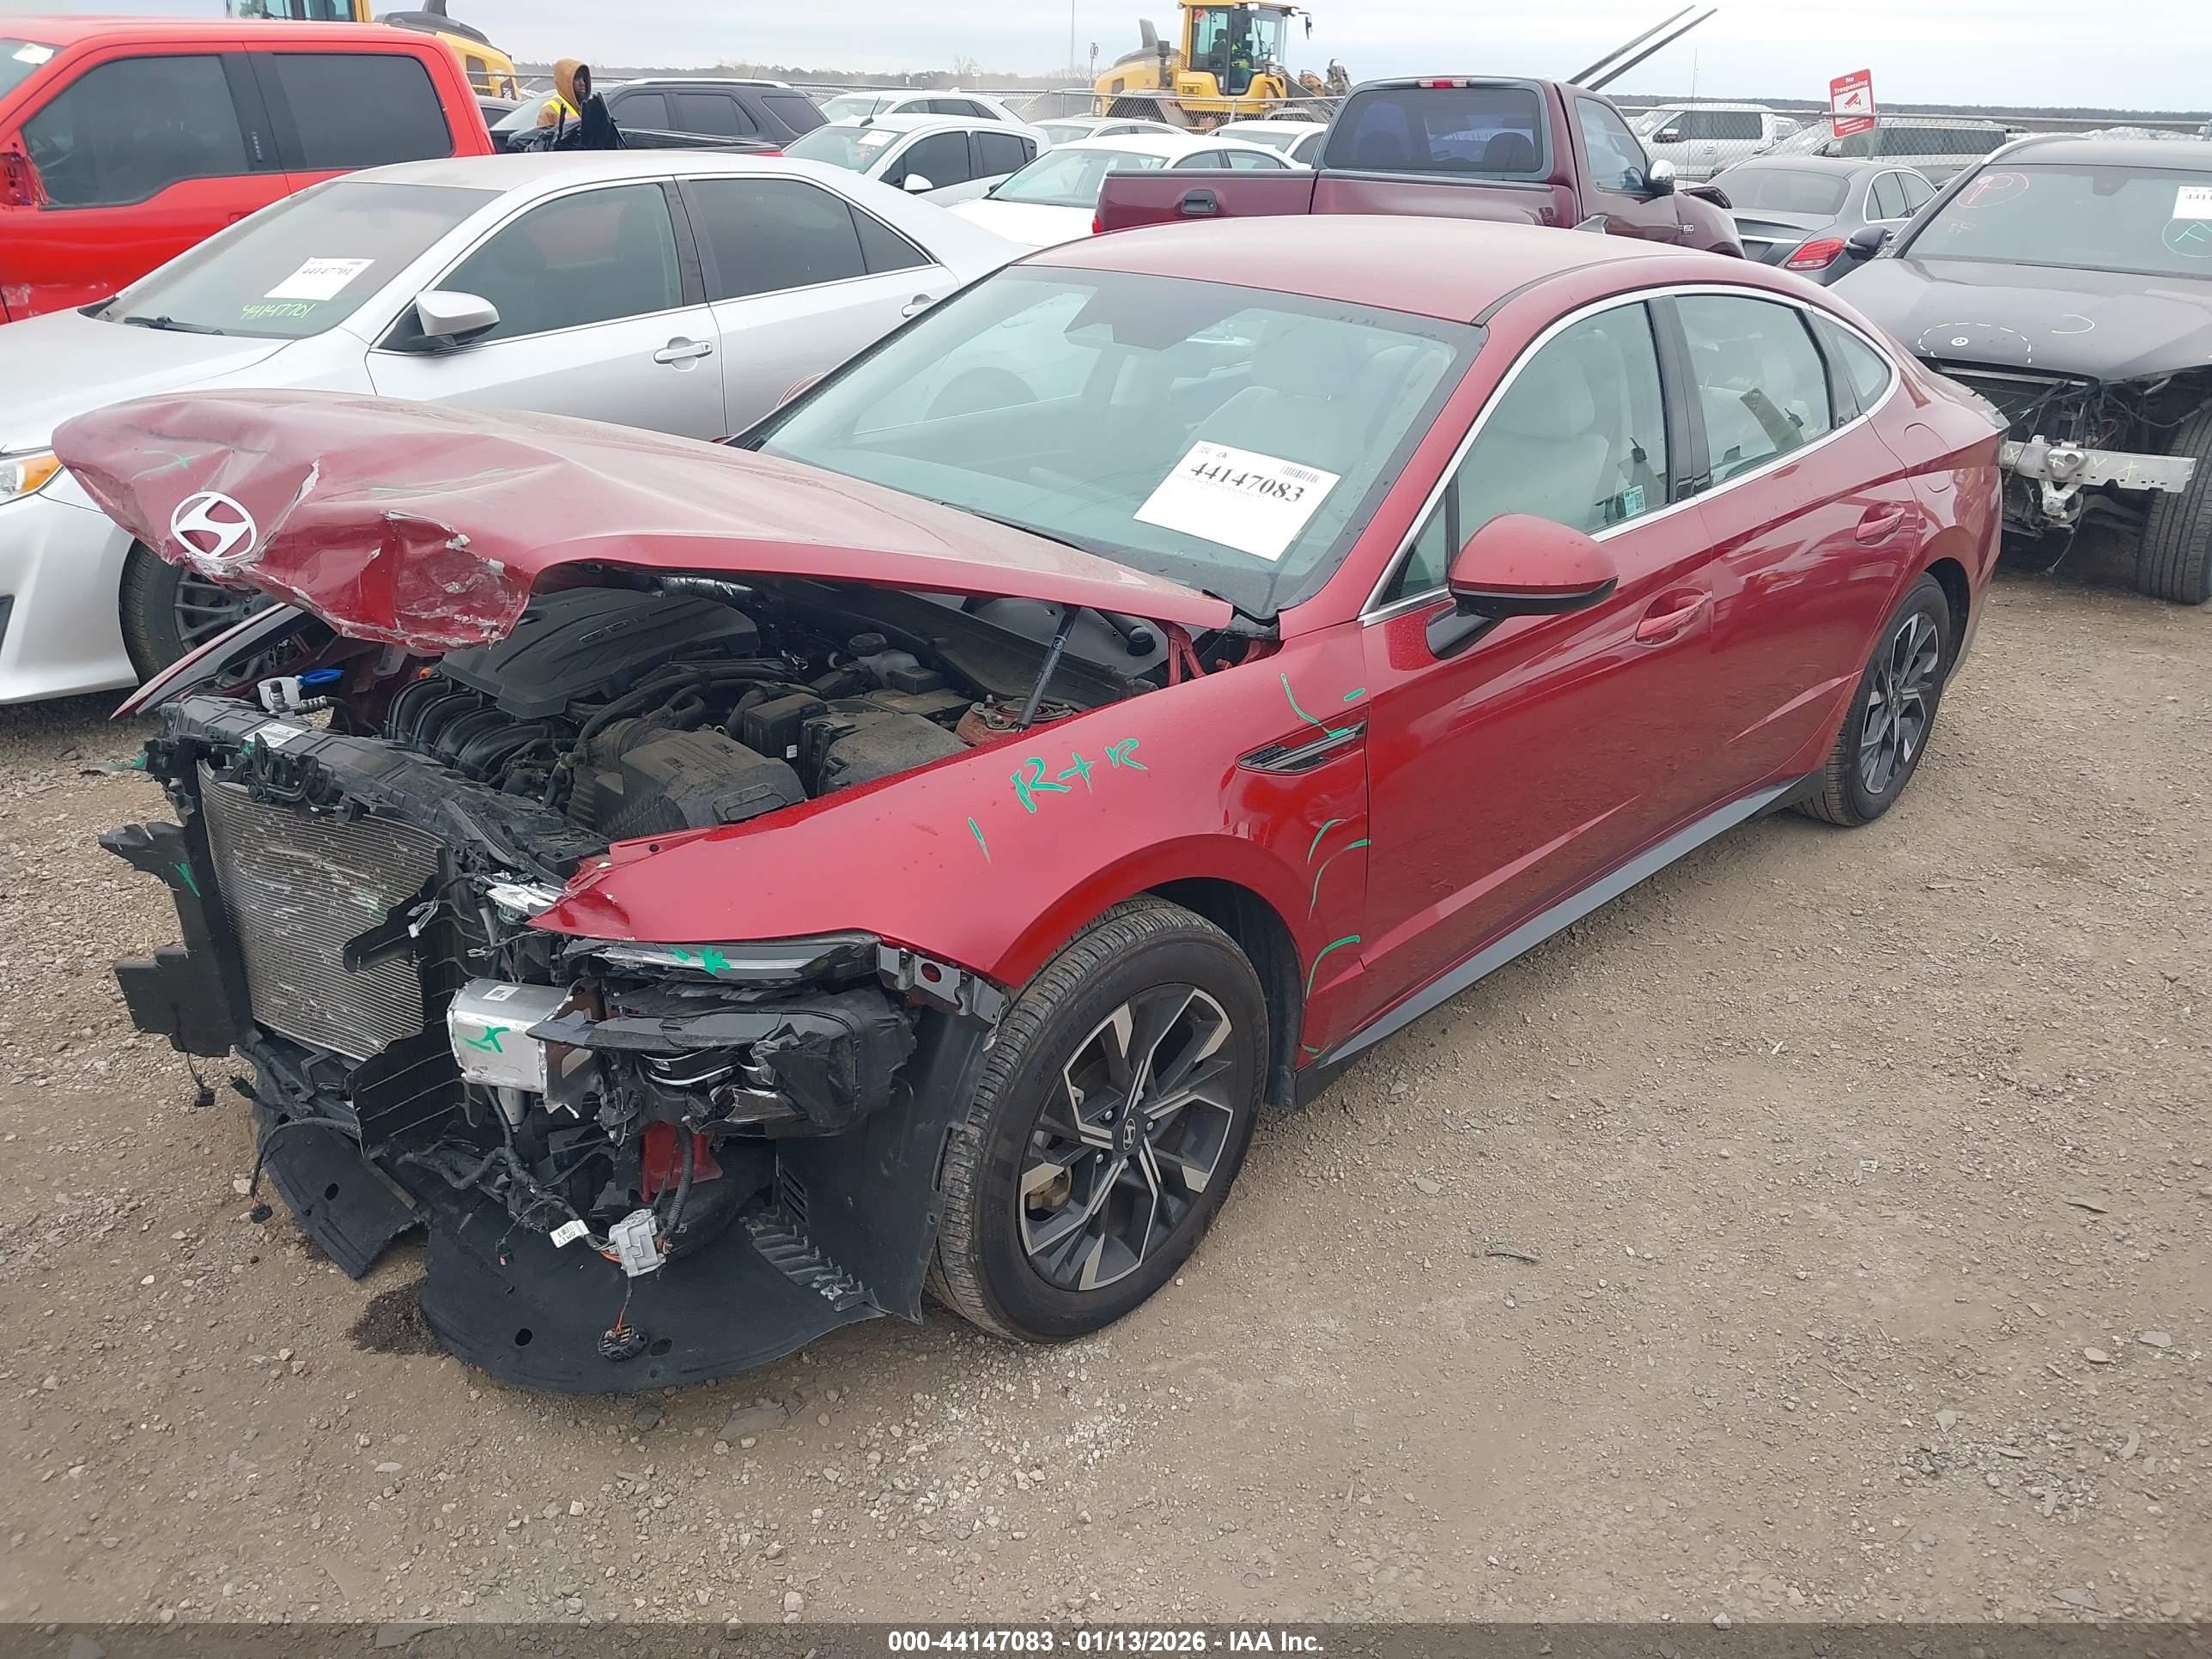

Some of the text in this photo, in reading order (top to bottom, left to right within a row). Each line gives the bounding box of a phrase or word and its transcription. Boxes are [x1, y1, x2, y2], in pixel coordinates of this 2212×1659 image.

[1833, 79, 1869, 94] Trespassing
[302, 267, 353, 276] 44147701
[240, 303, 316, 320] 44147701
[1190, 462, 1304, 501] 44147083
